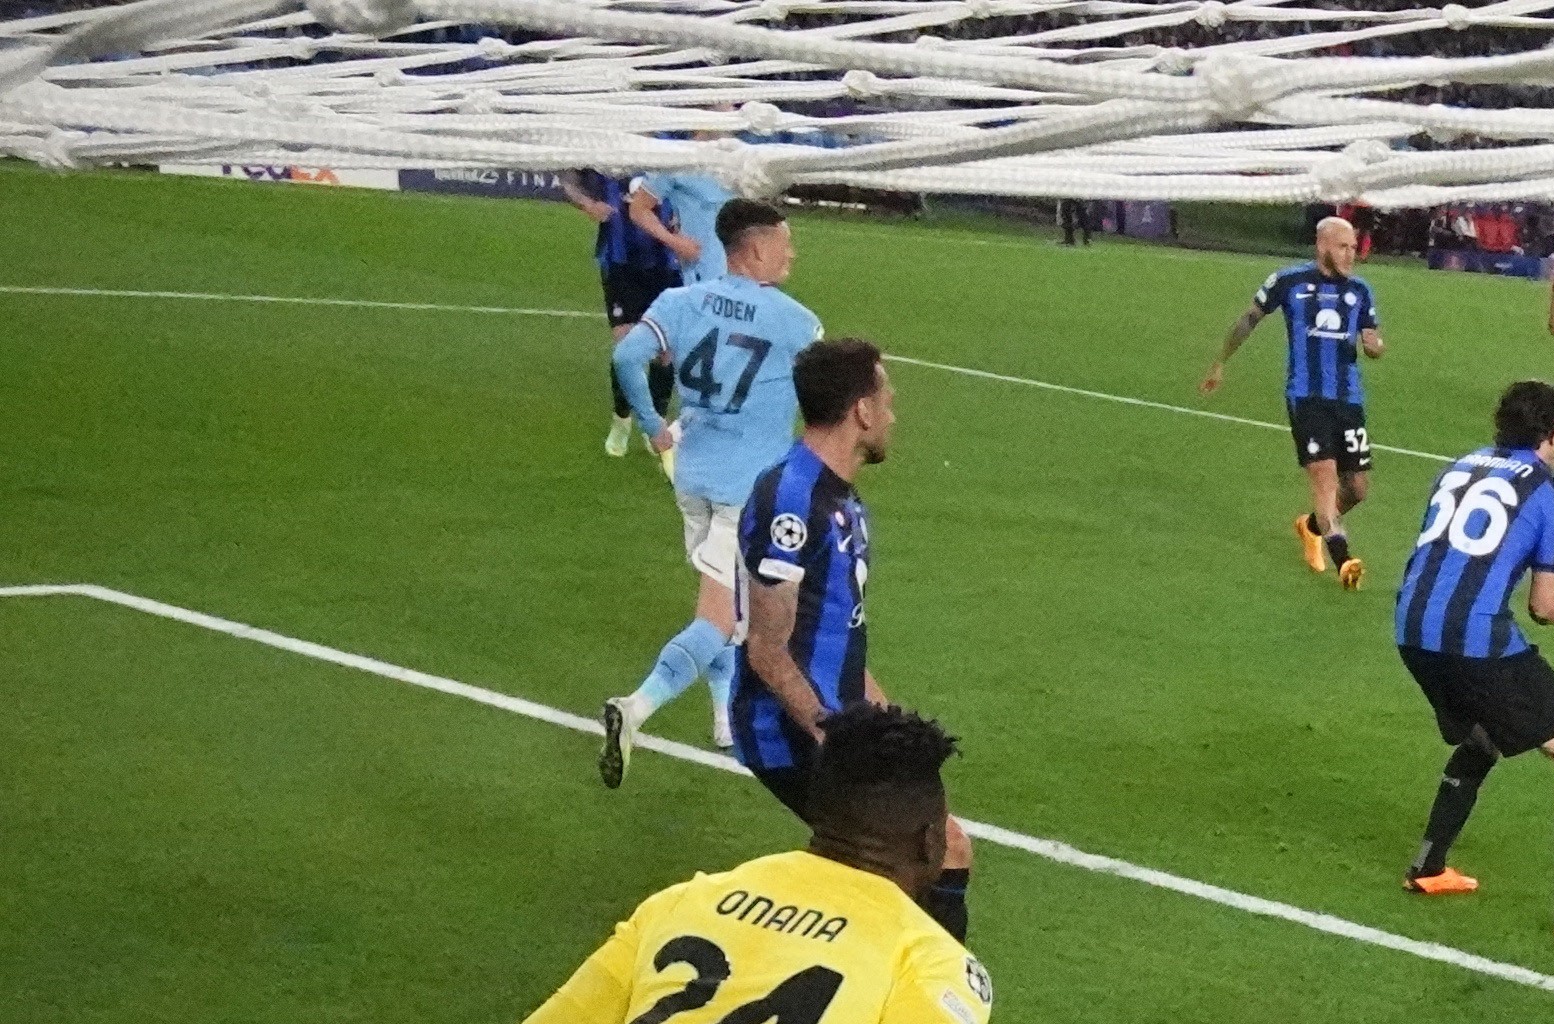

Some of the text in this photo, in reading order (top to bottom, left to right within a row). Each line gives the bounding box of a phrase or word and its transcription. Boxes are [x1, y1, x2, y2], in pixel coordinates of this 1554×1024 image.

[507, 170, 561, 188] FINA
[701, 292, 757, 322] FODEN
[679, 326, 772, 414] 47
[1344, 427, 1370, 453] 32
[1417, 471, 1518, 556] 36
[716, 890, 849, 943] ONANA
